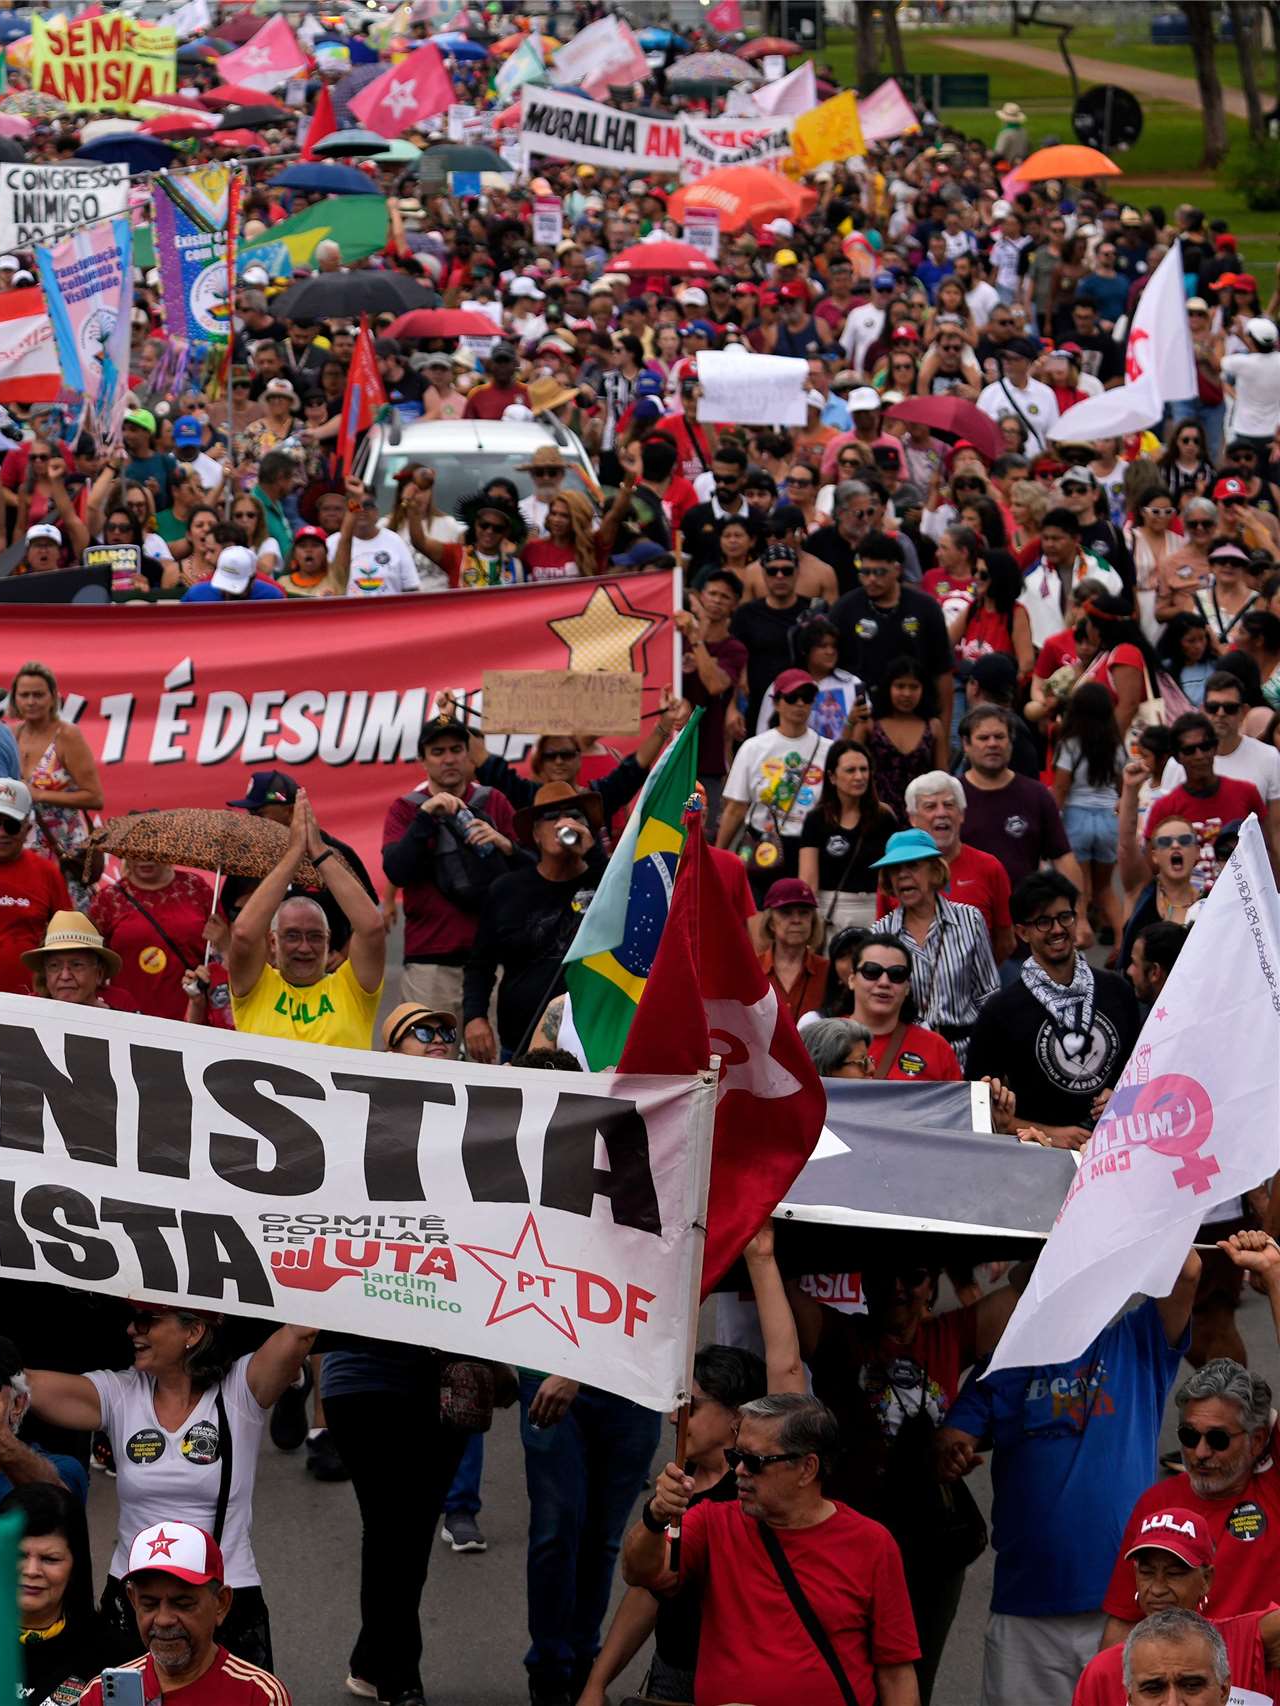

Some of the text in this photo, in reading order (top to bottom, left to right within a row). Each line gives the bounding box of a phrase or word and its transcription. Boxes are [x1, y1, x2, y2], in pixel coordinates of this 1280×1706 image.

[47, 18, 121, 57] SEM
[523, 102, 637, 153] MURALHA
[6, 167, 121, 191] CONGRESSO
[12, 194, 100, 224] INIMIGO
[147, 655, 197, 766] É
[195, 689, 537, 767] DESUM
[273, 991, 336, 1025] LULA
[257, 1212, 447, 1231] COMITÊ
[262, 1223, 450, 1245] POPULAR
[263, 1235, 305, 1245] DE
[361, 1268, 437, 1293] Jardim
[363, 1284, 462, 1314] Botânico
[517, 1270, 657, 1338] PT DF
[1141, 1513, 1197, 1539] LULA
[155, 1541, 169, 1550] PT
